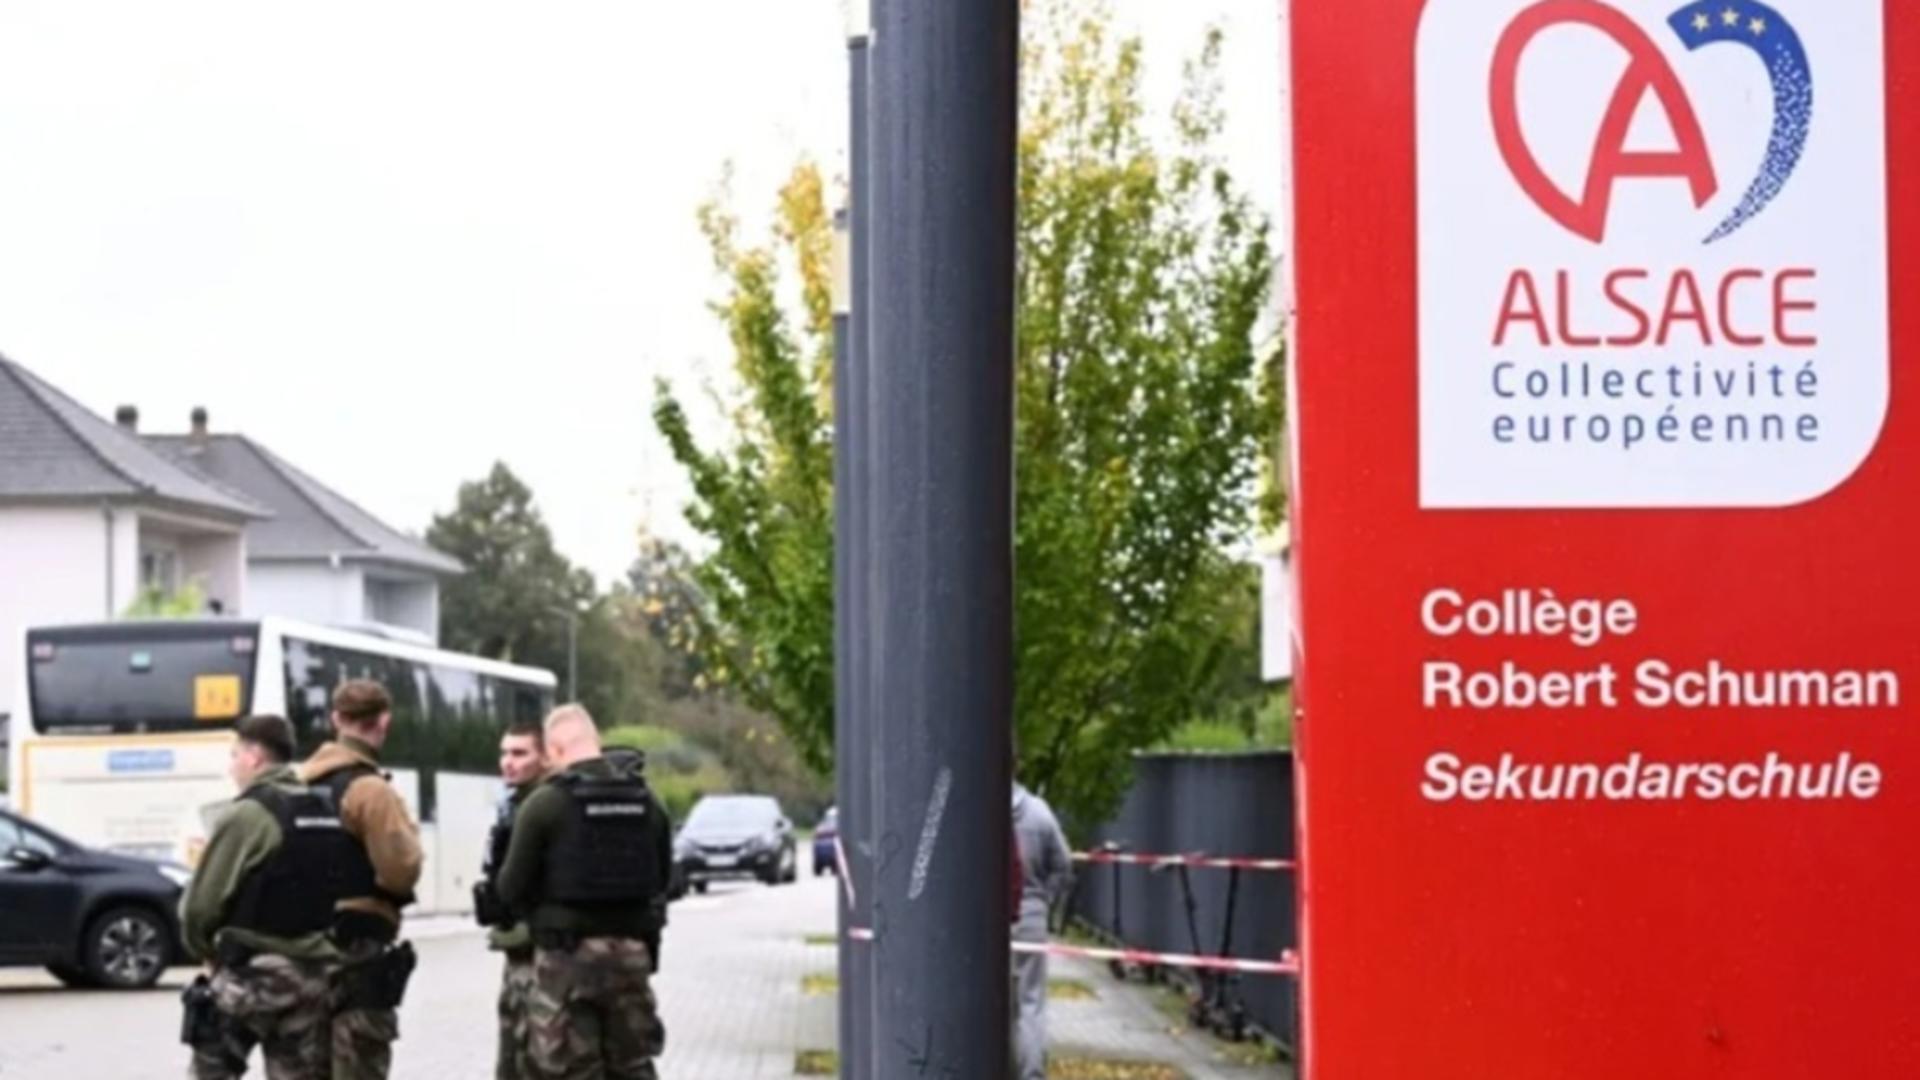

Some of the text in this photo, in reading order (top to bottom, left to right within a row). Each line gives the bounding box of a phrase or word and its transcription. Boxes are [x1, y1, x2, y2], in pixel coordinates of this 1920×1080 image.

[1491, 268, 1817, 347] ALSACE
[1492, 360, 1818, 399] Collectivité
[1492, 405, 1819, 450] européenne
[1420, 588, 1637, 647] Collège
[1421, 659, 1899, 708] Robert Schuman
[1420, 751, 1881, 802] Sekundarschule
